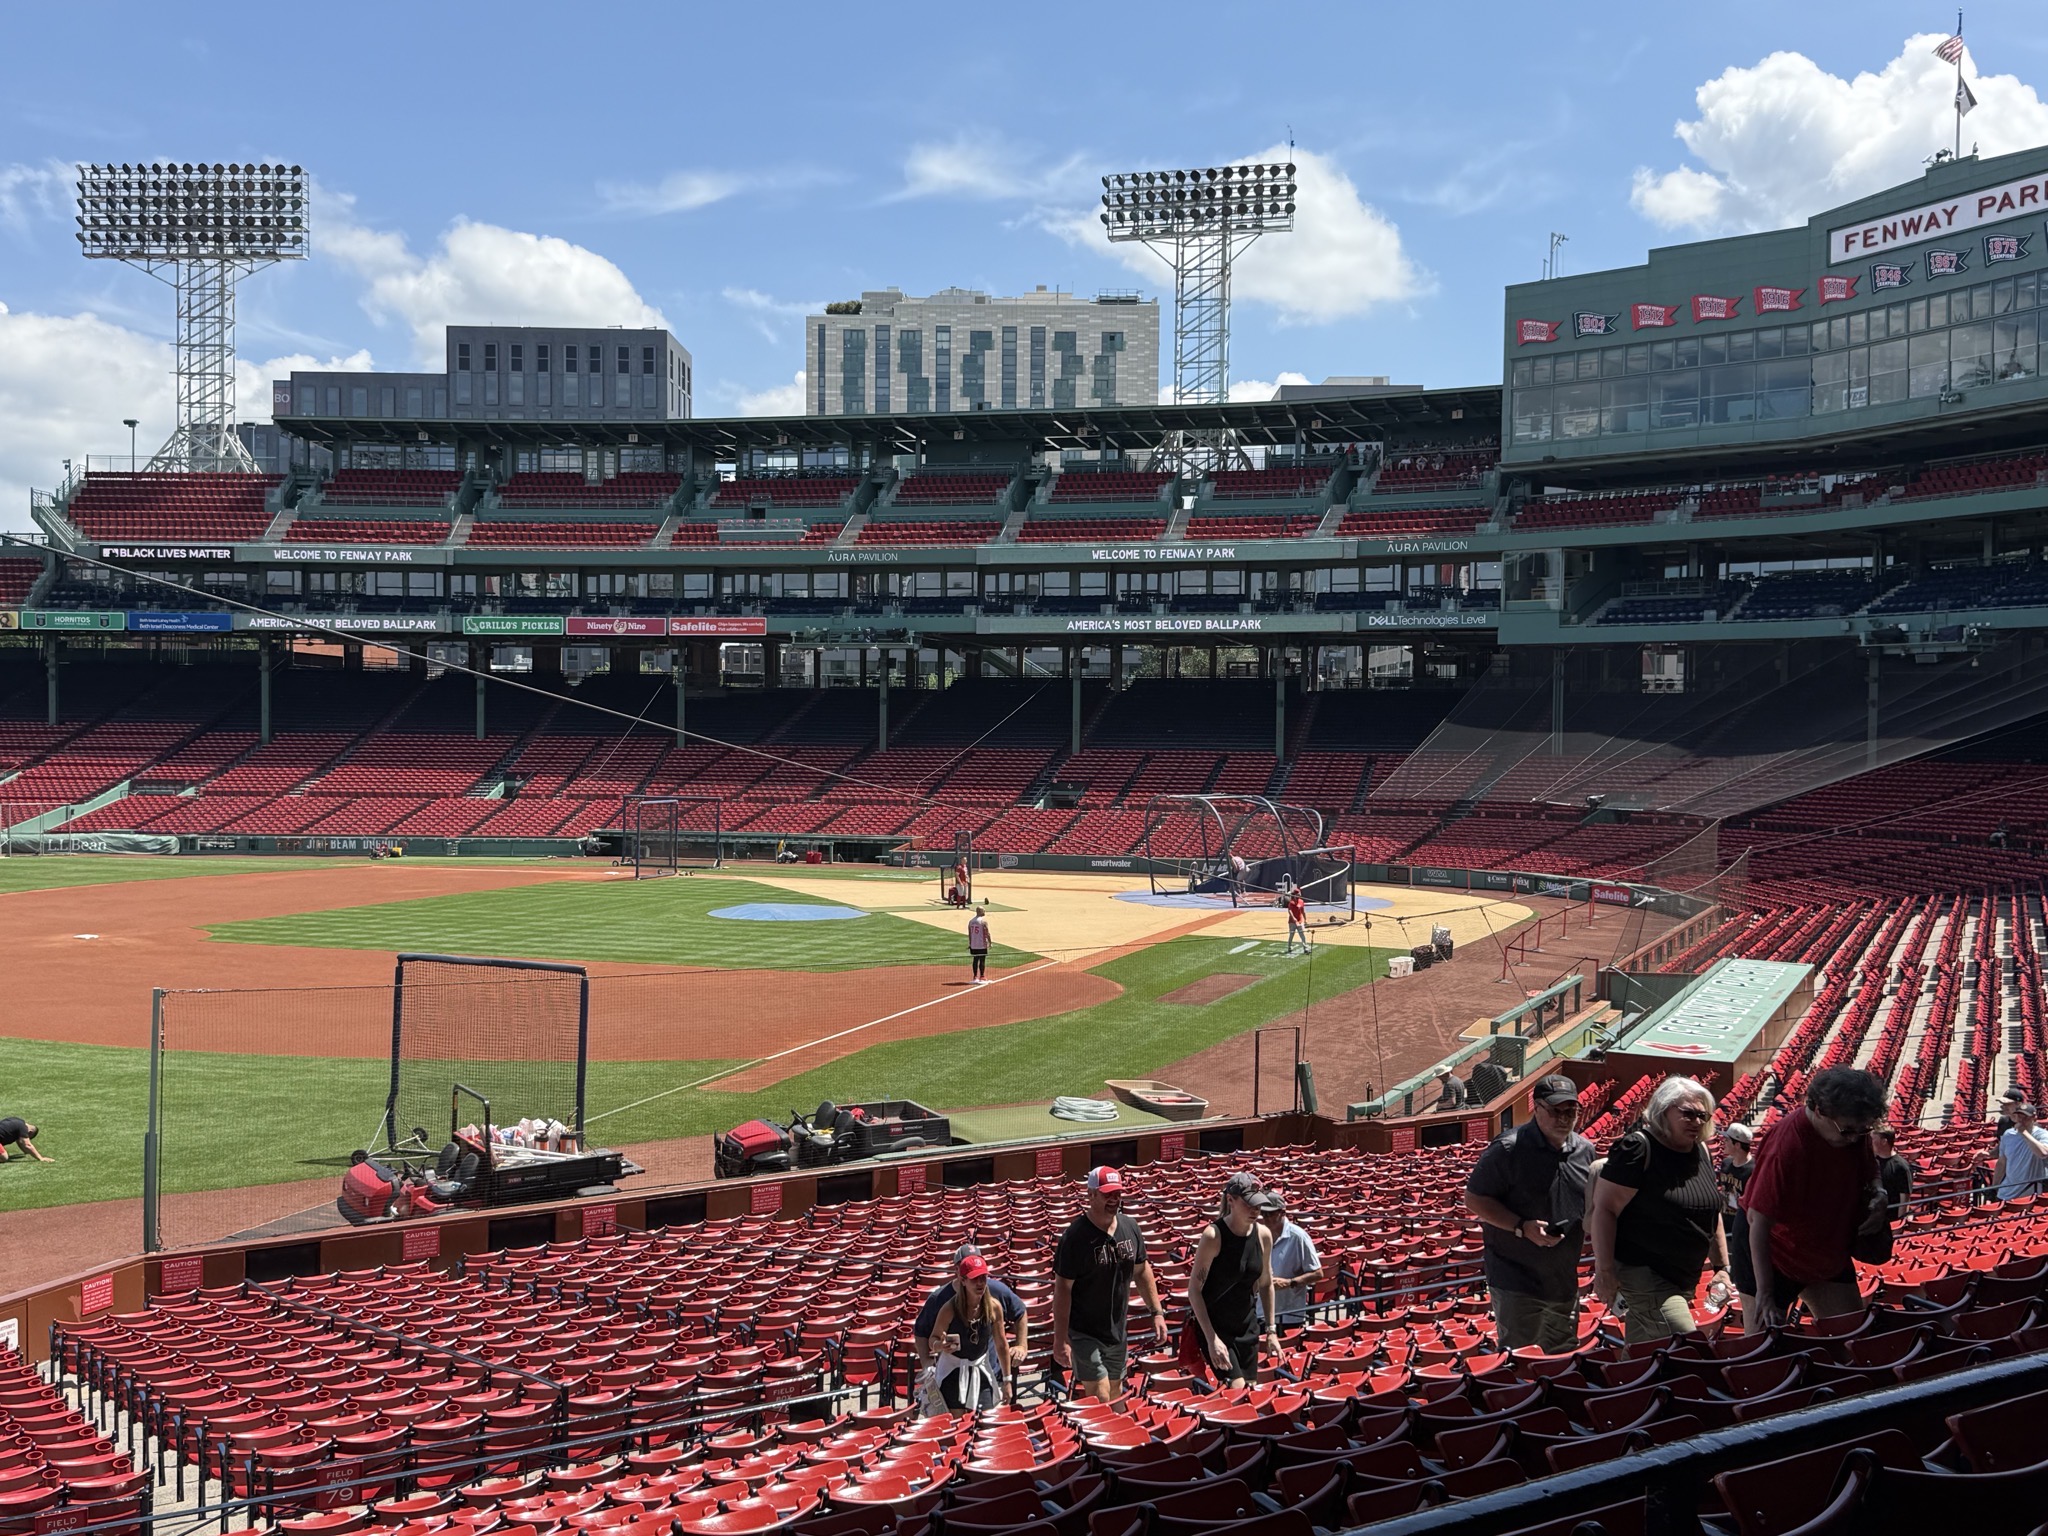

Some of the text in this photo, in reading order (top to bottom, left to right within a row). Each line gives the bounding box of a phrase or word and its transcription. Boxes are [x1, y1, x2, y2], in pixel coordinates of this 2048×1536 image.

[1844, 205, 1959, 253] FENWAY
[1988, 240, 2018, 255] 1975
[1930, 256, 1958, 269] 1967
[1875, 270, 1902, 282] 1946
[1762, 293, 1790, 305] 1916
[1699, 302, 1726, 313] 1915
[1639, 310, 1664, 320] 1912
[1578, 318, 1606, 329] 1904
[1422, 540, 1468, 551] PAVILION
[120, 548, 230, 558] BLACK LIVES MATTER
[274, 550, 412, 562] WELCOME TO FENWAY PARK
[859, 553, 898, 562] PAVILION
[1092, 548, 1235, 560] WELCOME TO FENWAY PARK
[304, 619, 332, 628] MOST
[336, 620, 380, 628] BELOVED
[383, 620, 436, 630] BALLPARK
[480, 622, 560, 630] GRILLO'S PICKLES
[1066, 620, 1261, 630] AMERICA'S MOST BELOVED BALLPARK
[1368, 614, 1486, 627] DELL Technologies Level
[586, 622, 613, 631] Ninety
[672, 622, 717, 631] Safelite
[330, 839, 356, 850] BEAM
[1092, 859, 1131, 867] smartwater
[1594, 888, 1629, 902] Safelite
[754, 1186, 780, 1194] CAUTION!
[1956, 1194, 1966, 1204] 72
[584, 1208, 615, 1216] CAUTION!
[406, 1230, 438, 1238] CAUTION!
[164, 1260, 201, 1269] CAUTION!
[84, 1278, 112, 1290] CAUTION!
[1400, 1292, 1415, 1302] 75
[773, 1386, 795, 1396] FIELD
[326, 1468, 354, 1480] FIELD
[330, 1477, 350, 1486] BOX
[326, 1487, 354, 1504] 79
[46, 1517, 77, 1529] FIELD
